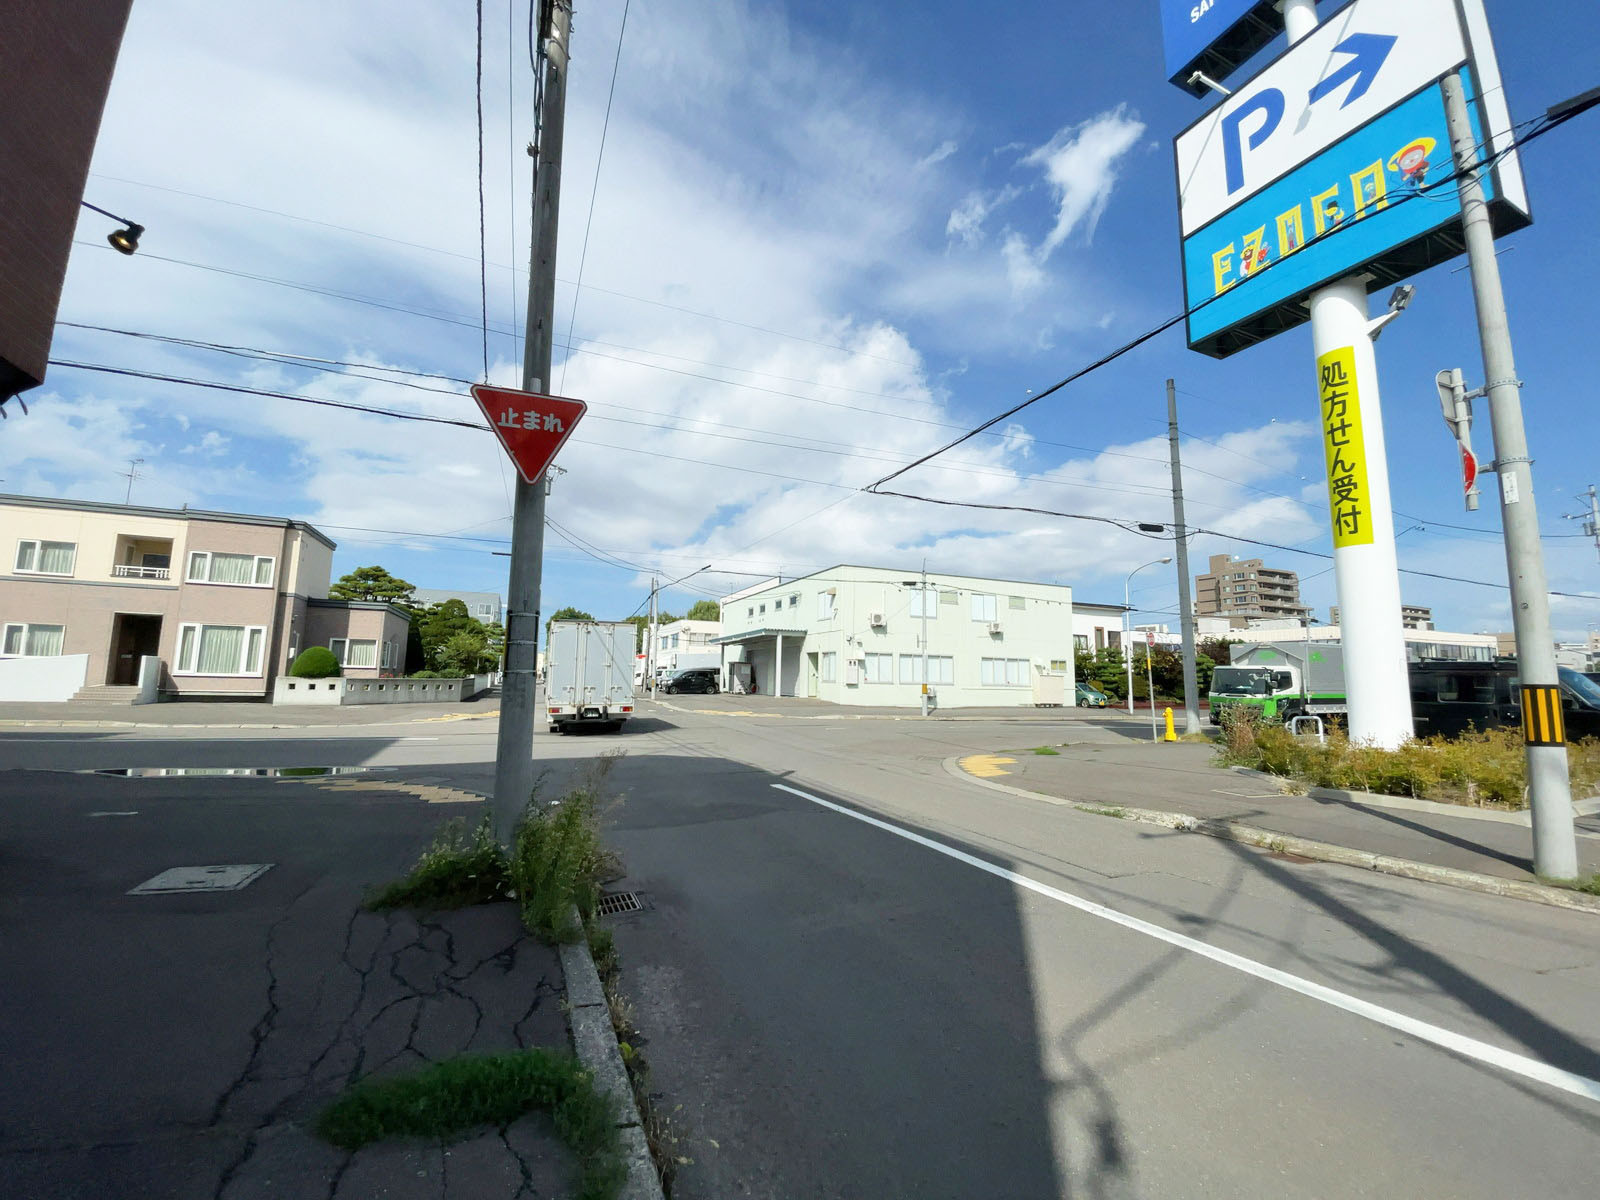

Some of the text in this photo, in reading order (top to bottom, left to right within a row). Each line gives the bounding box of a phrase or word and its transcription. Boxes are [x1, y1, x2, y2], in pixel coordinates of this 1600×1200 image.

[1221, 87, 1286, 197] P
[497, 407, 565, 433] 止まれ
[1320, 360, 1363, 537] 処方せん受付
